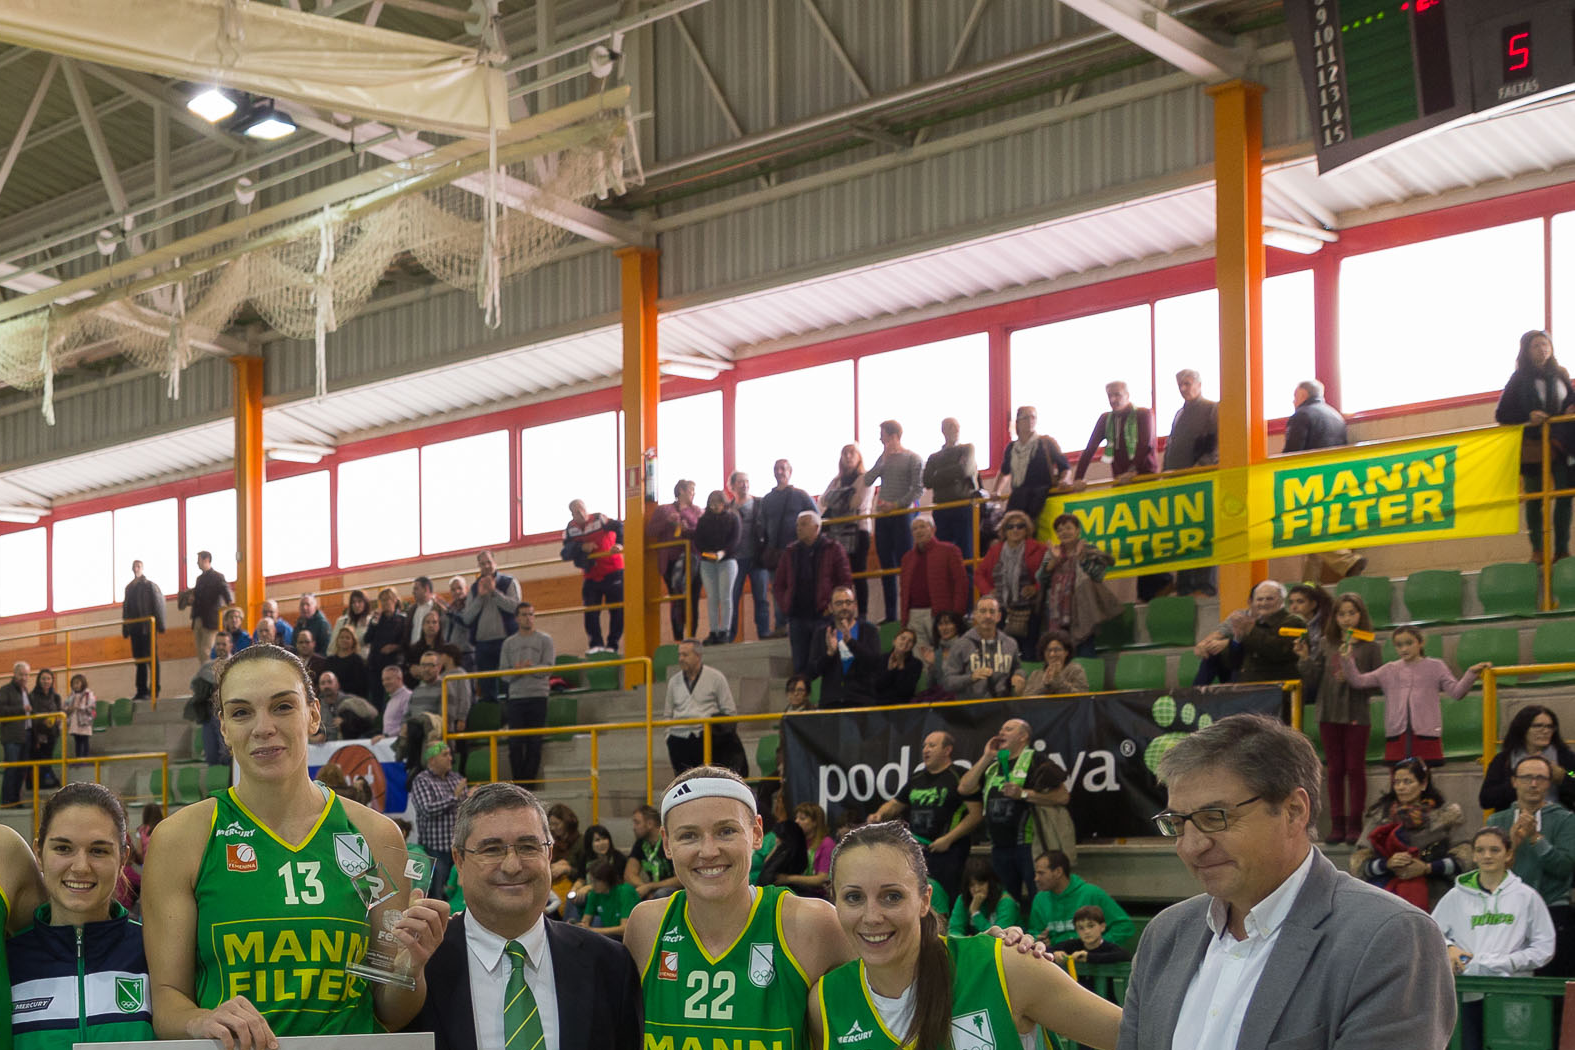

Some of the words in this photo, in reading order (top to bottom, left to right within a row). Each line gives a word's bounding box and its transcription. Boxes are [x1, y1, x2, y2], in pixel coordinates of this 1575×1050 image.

[1314, 25, 1334, 48] 10
[1316, 46, 1336, 67] 11
[1509, 32, 1529, 71] 5
[1318, 65, 1338, 87] 12
[1320, 85, 1341, 107] 13
[1498, 79, 1539, 100] FALTAS
[1322, 106, 1343, 127] 14
[1324, 126, 1345, 147] 15
[1283, 455, 1446, 509] MANN
[1072, 491, 1205, 536] MANN
[1282, 490, 1445, 540] FILTER
[278, 861, 324, 905] 13
[223, 929, 369, 965] MANN
[229, 968, 362, 1002] FILTER
[684, 970, 736, 1020] 22
[15, 1000, 48, 1010] MERCURY
[837, 1030, 873, 1044] MERCURY
